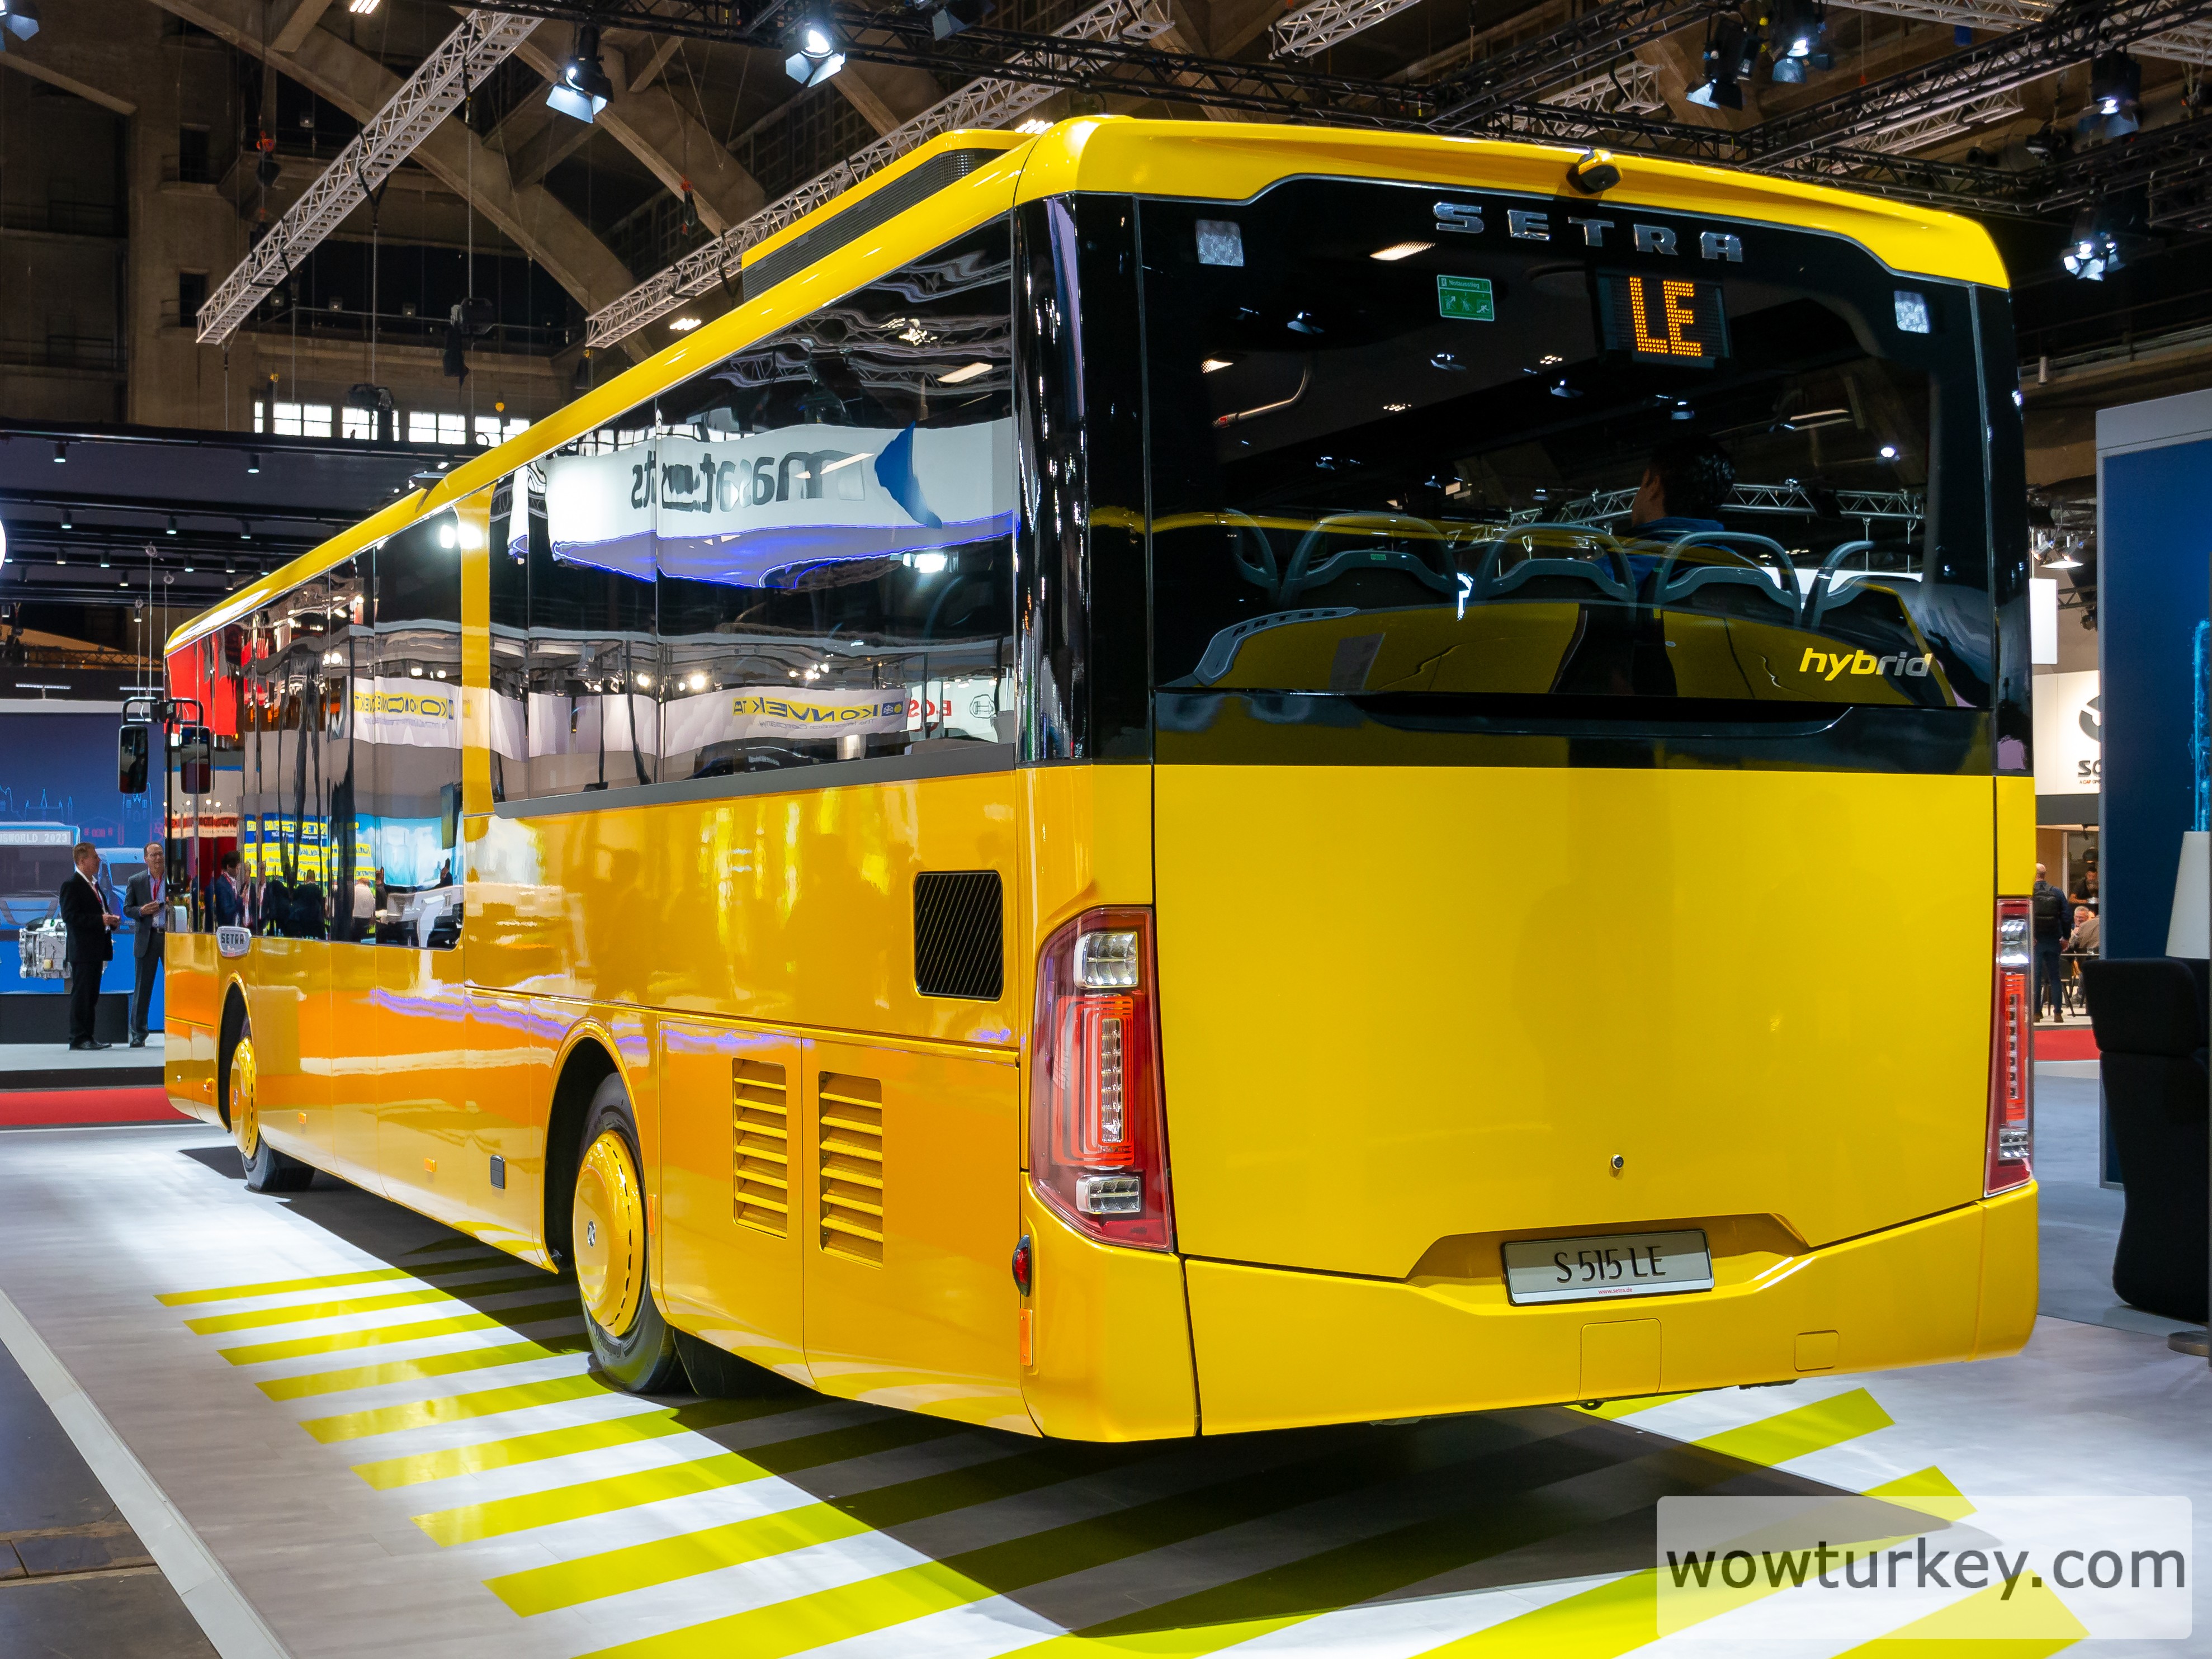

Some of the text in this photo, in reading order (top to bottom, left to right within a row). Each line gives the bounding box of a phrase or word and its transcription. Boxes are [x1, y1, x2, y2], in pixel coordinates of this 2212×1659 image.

[1433, 202, 1743, 262] SETRA
[1629, 277, 1702, 357] LE
[1799, 647, 1932, 681] hybrid
[44, 833, 67, 843] 2023
[221, 933, 244, 944] SETRA
[1554, 1245, 1667, 1284] S 515 LE
